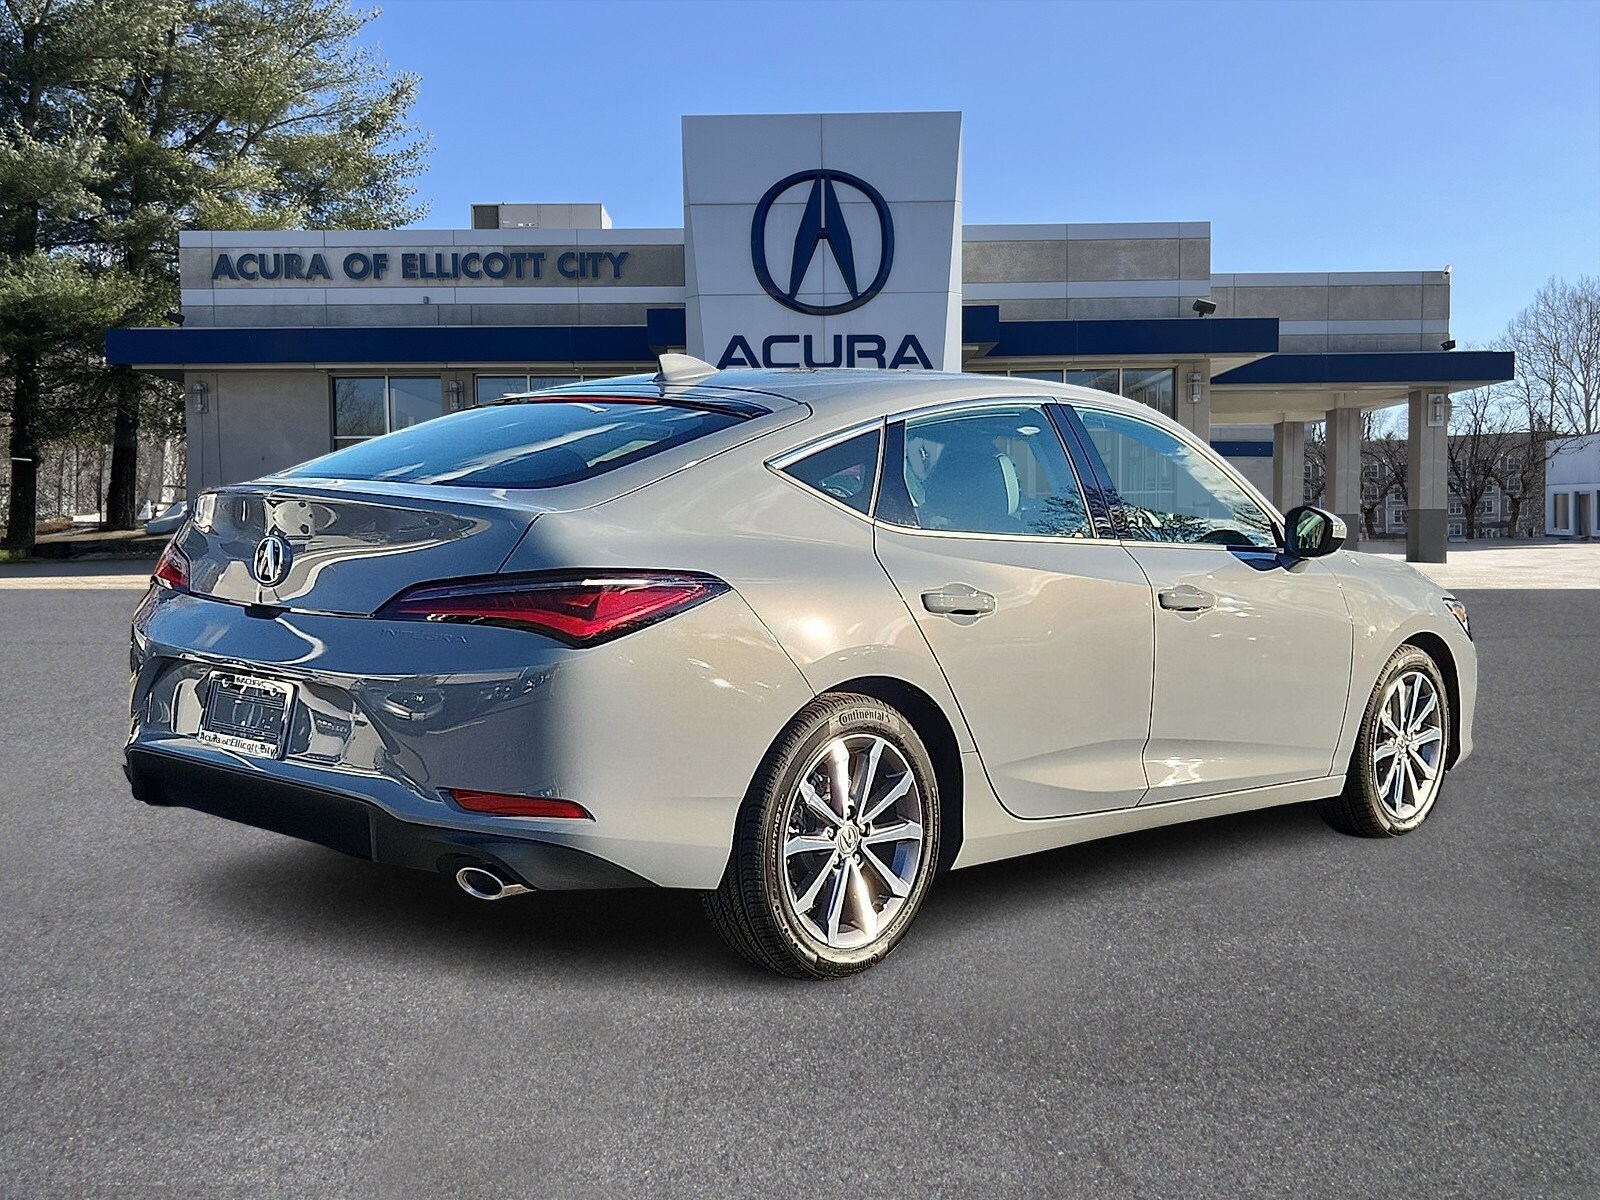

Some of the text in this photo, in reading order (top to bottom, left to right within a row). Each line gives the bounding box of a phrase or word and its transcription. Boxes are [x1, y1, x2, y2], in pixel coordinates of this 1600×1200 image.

[211, 251, 629, 281] ACURA OF ELLICOTT CITY
[716, 334, 934, 369] ACURA
[838, 709, 885, 726] Continental
